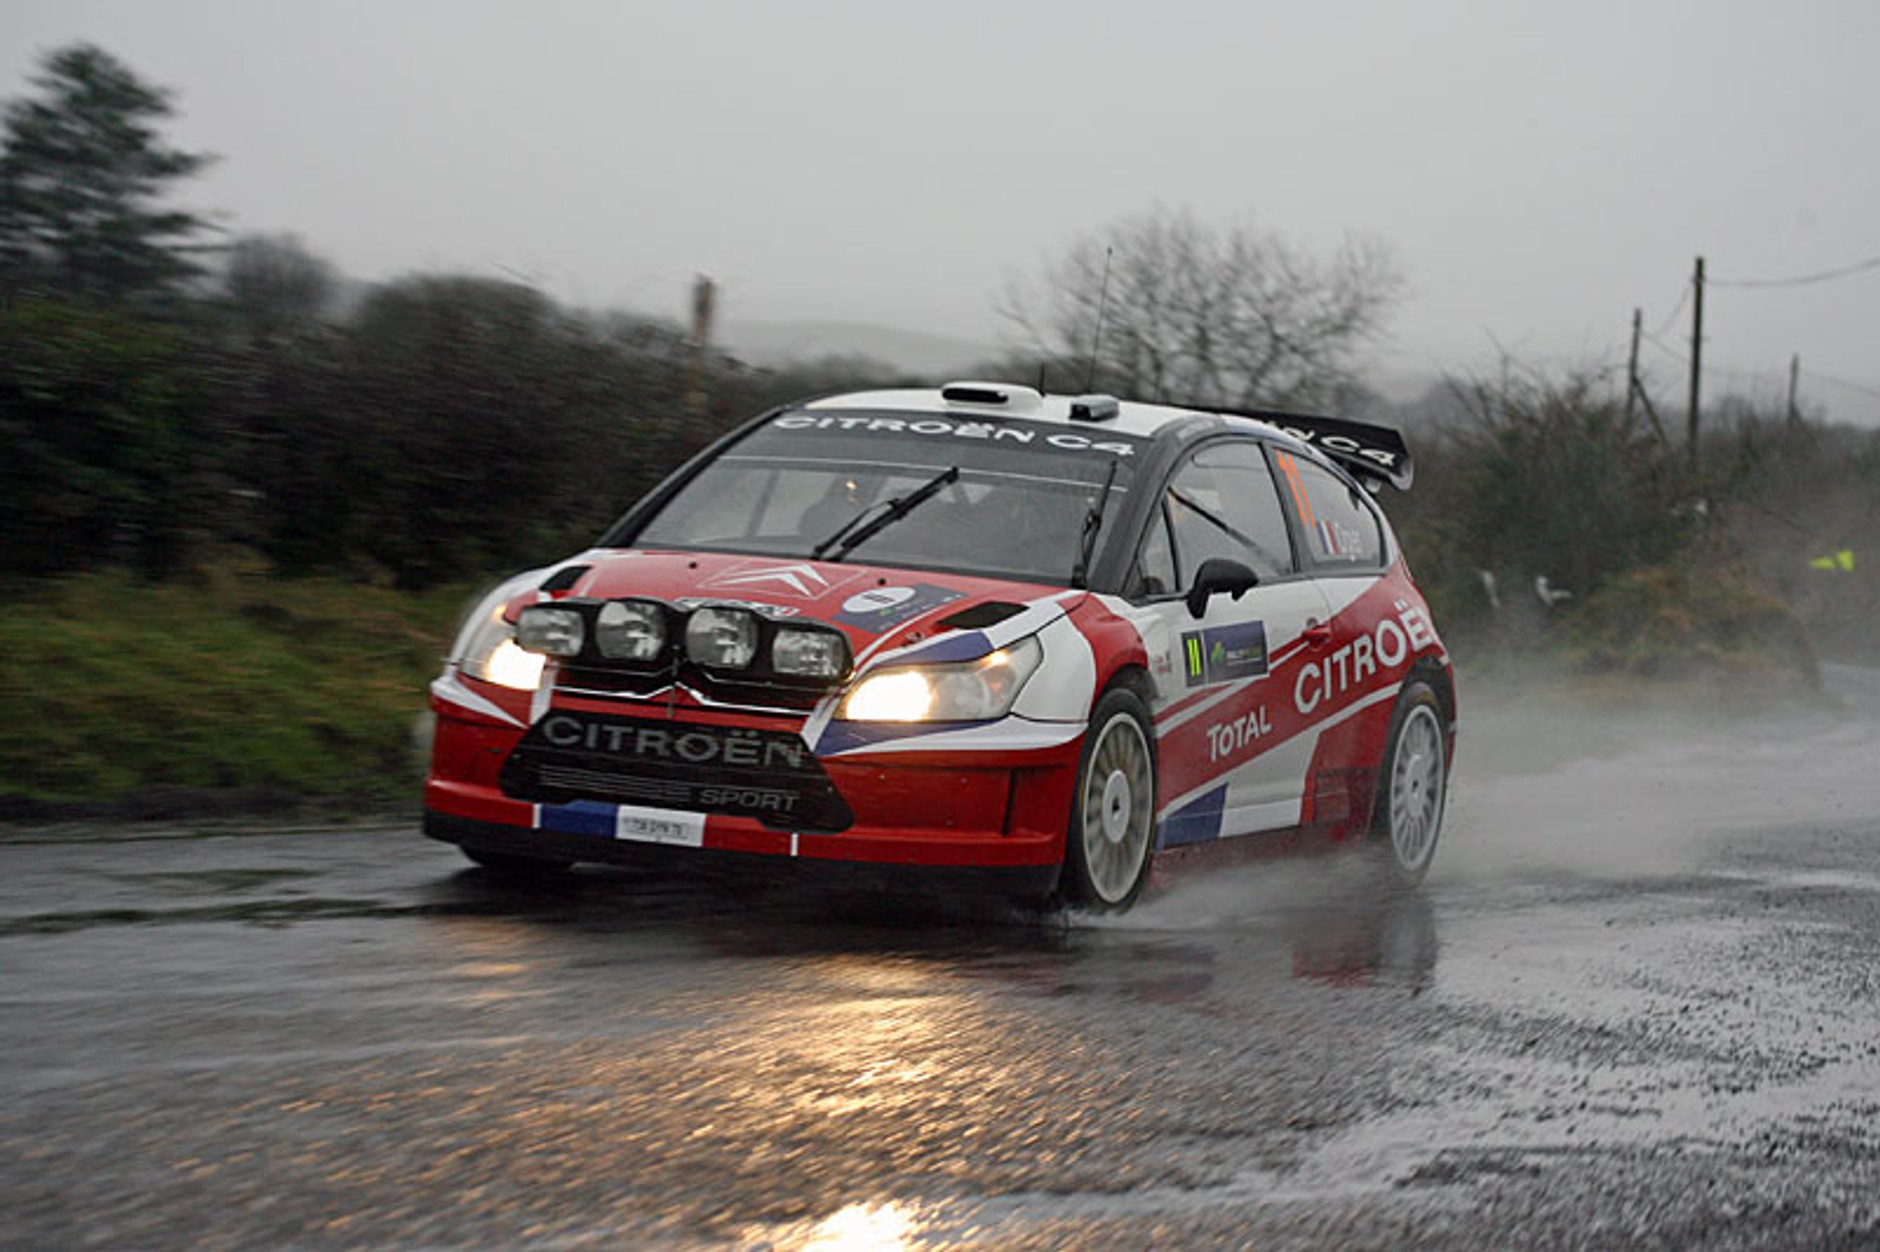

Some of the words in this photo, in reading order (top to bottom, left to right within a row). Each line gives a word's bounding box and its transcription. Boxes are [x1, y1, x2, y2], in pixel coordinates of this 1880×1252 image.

[773, 416, 1035, 443] CITROËN
[1046, 434, 1134, 455] C4
[1320, 436, 1394, 466] C4
[1294, 598, 1434, 714] CITROË
[543, 716, 802, 767] CITROËN
[1206, 705, 1272, 763] TOTAL
[700, 788, 799, 812] SPORT
